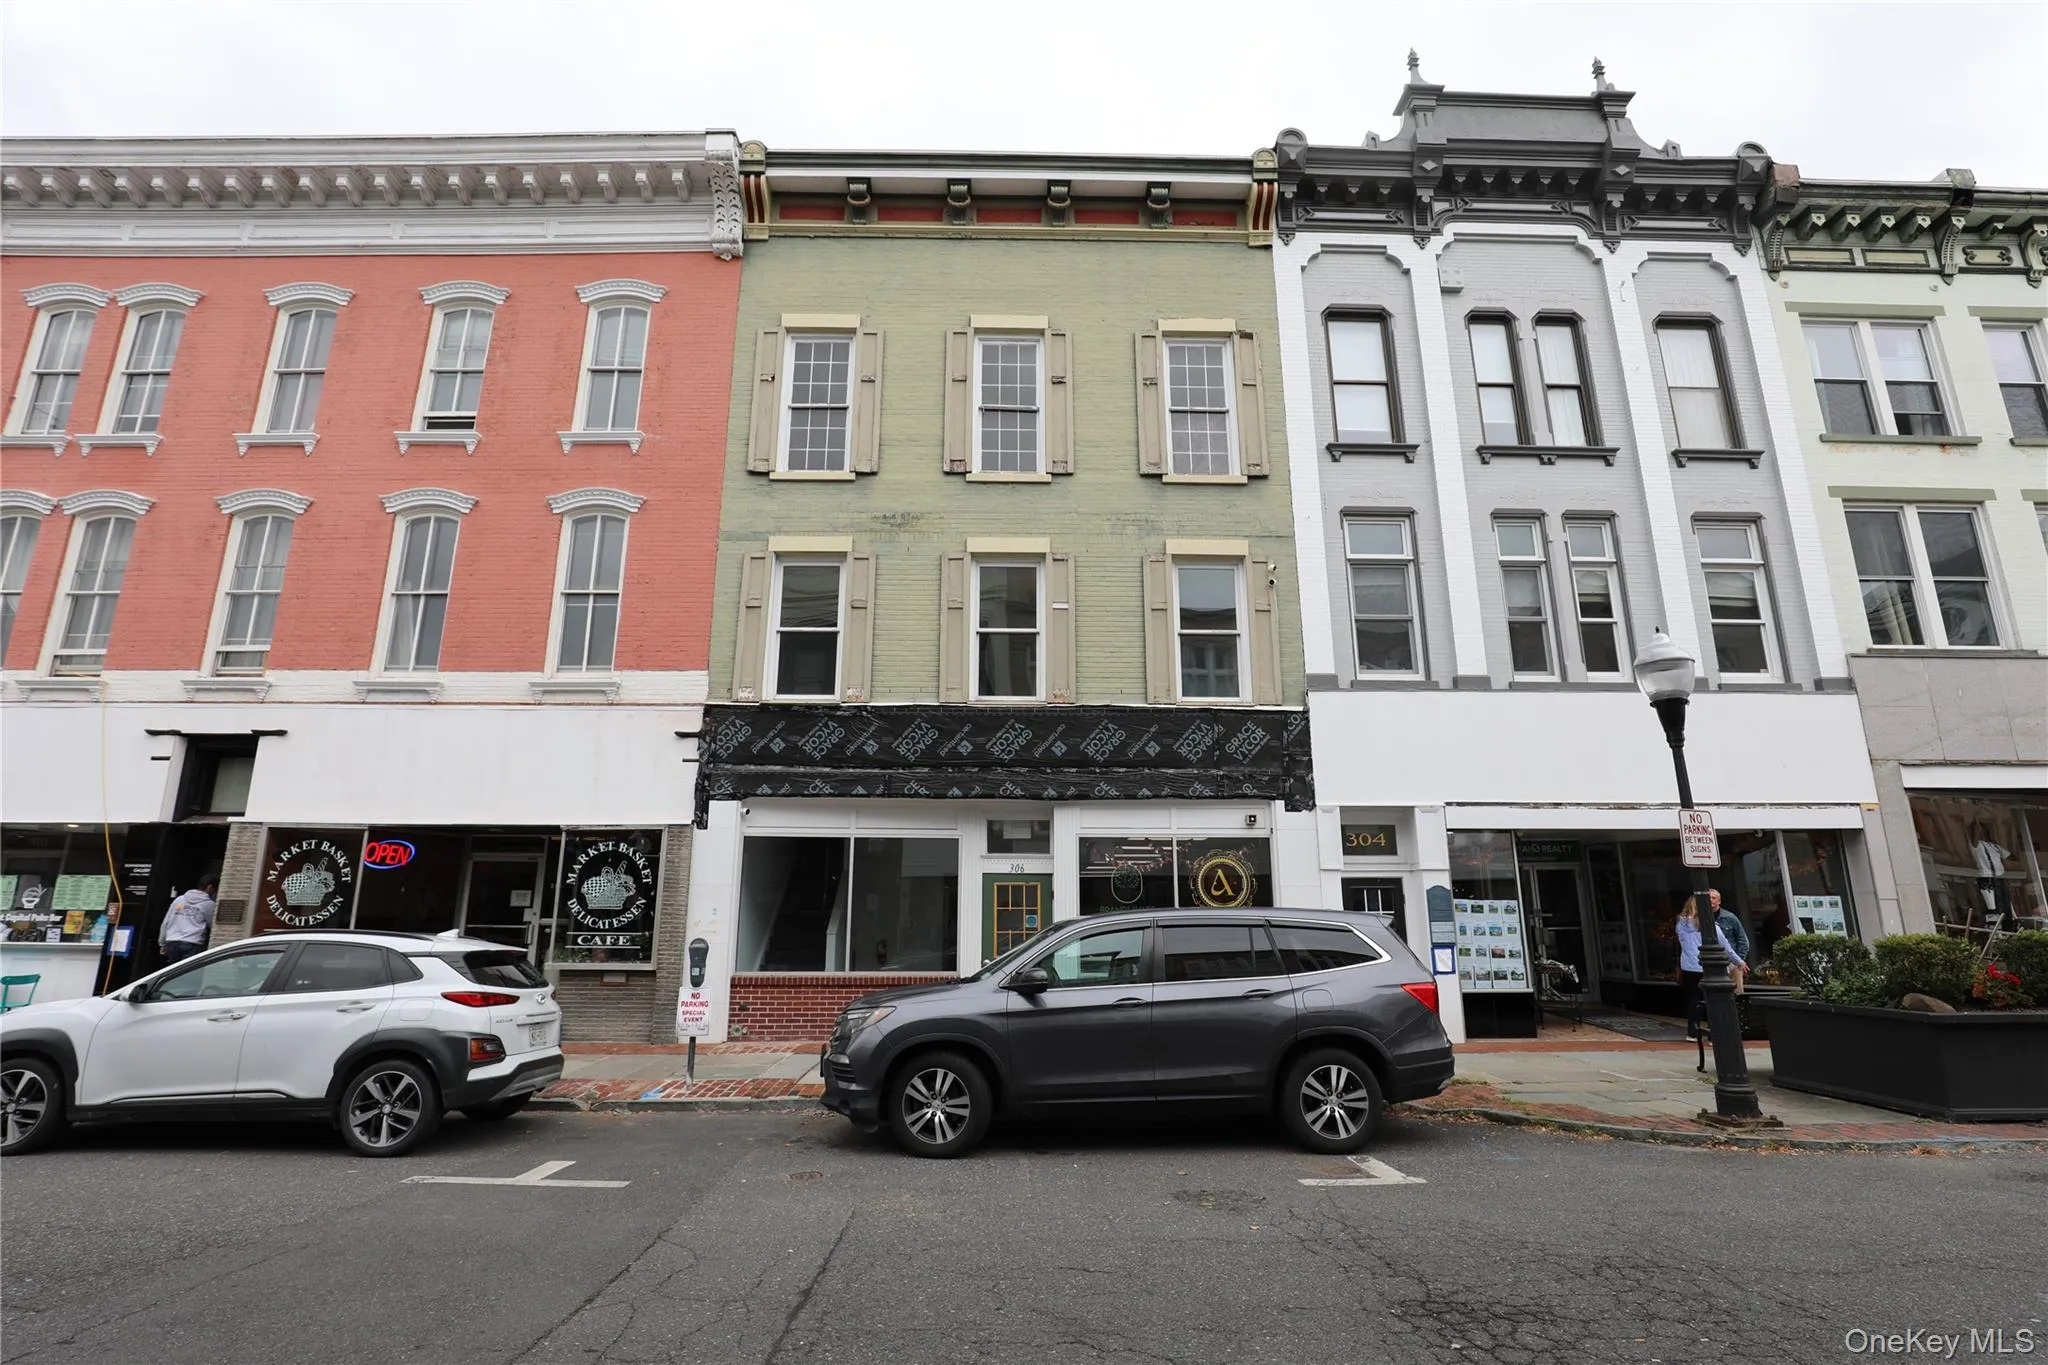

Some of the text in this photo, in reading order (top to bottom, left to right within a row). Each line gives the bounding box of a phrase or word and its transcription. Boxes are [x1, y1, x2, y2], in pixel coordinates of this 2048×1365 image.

[713, 719, 745, 749] VYCO
[717, 726, 752, 759] GRACE
[802, 720, 838, 754] VYCOR
[811, 727, 845, 761] GRACE
[896, 722, 931, 756] VYCOR
[904, 729, 939, 762] GRACE
[991, 722, 1025, 756] VYCOR
[999, 729, 1033, 763] GRACE
[1083, 722, 1118, 757] VYCOR
[1093, 729, 1126, 763] GRACE
[1177, 723, 1211, 757] VYCOR
[1225, 720, 1257, 754] GRACE
[1232, 727, 1266, 762] VYCOR
[1683, 825, 1712, 835] PARKING
[1689, 813, 1702, 824] NO
[365, 842, 411, 866] OPEN
[1346, 832, 1387, 847] 304
[1685, 836, 1714, 844] BETWEEN
[1690, 845, 1711, 853] SIGNS
[267, 839, 352, 883] MARKET BASKET
[566, 841, 652, 885] MARKET BASKET
[1009, 863, 1025, 873] 306
[266, 894, 344, 927] DELICATESSEN
[567, 896, 647, 929] DELICATESSEN
[577, 935, 631, 946] CAFE
[691, 992, 701, 1000] NO
